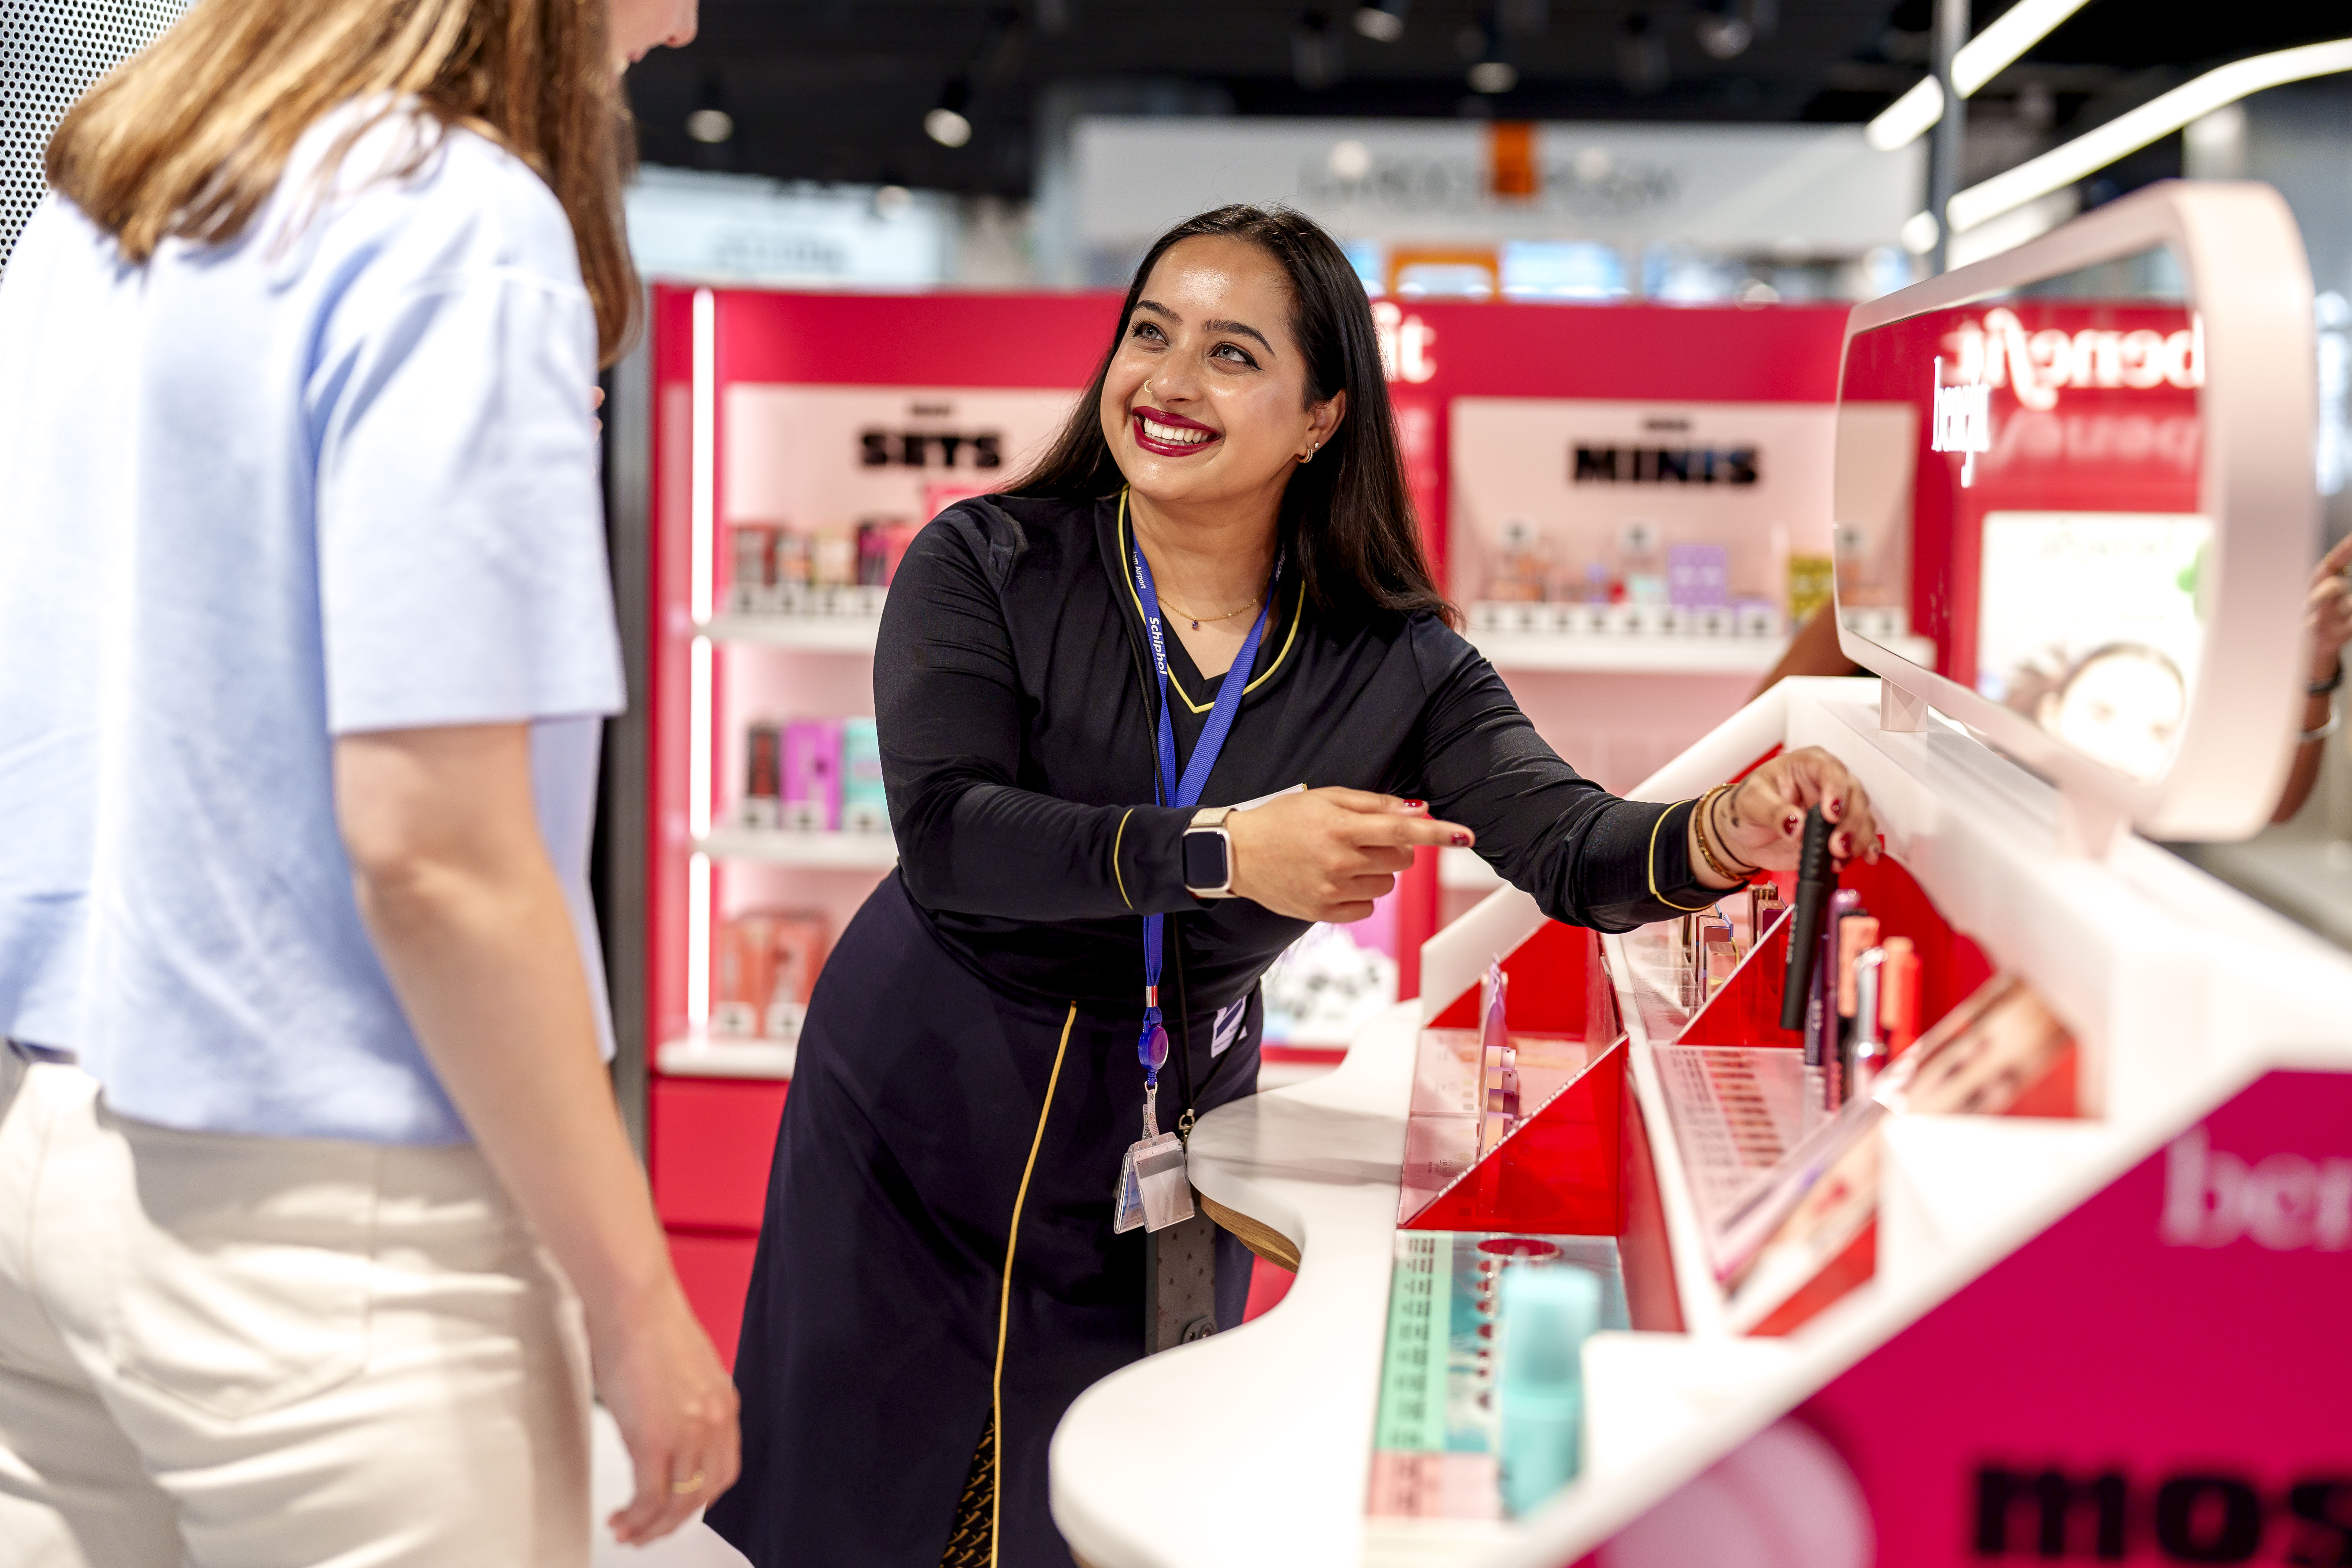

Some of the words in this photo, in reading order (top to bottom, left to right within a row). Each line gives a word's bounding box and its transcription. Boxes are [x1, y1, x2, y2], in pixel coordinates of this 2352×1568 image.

[862, 432, 1002, 467] SETS
[1573, 446, 1757, 484] MINIS
[1135, 566, 1146, 588] Airport
[1275, 542, 1286, 581] Schip
[1149, 617, 1167, 675] Schiphol
